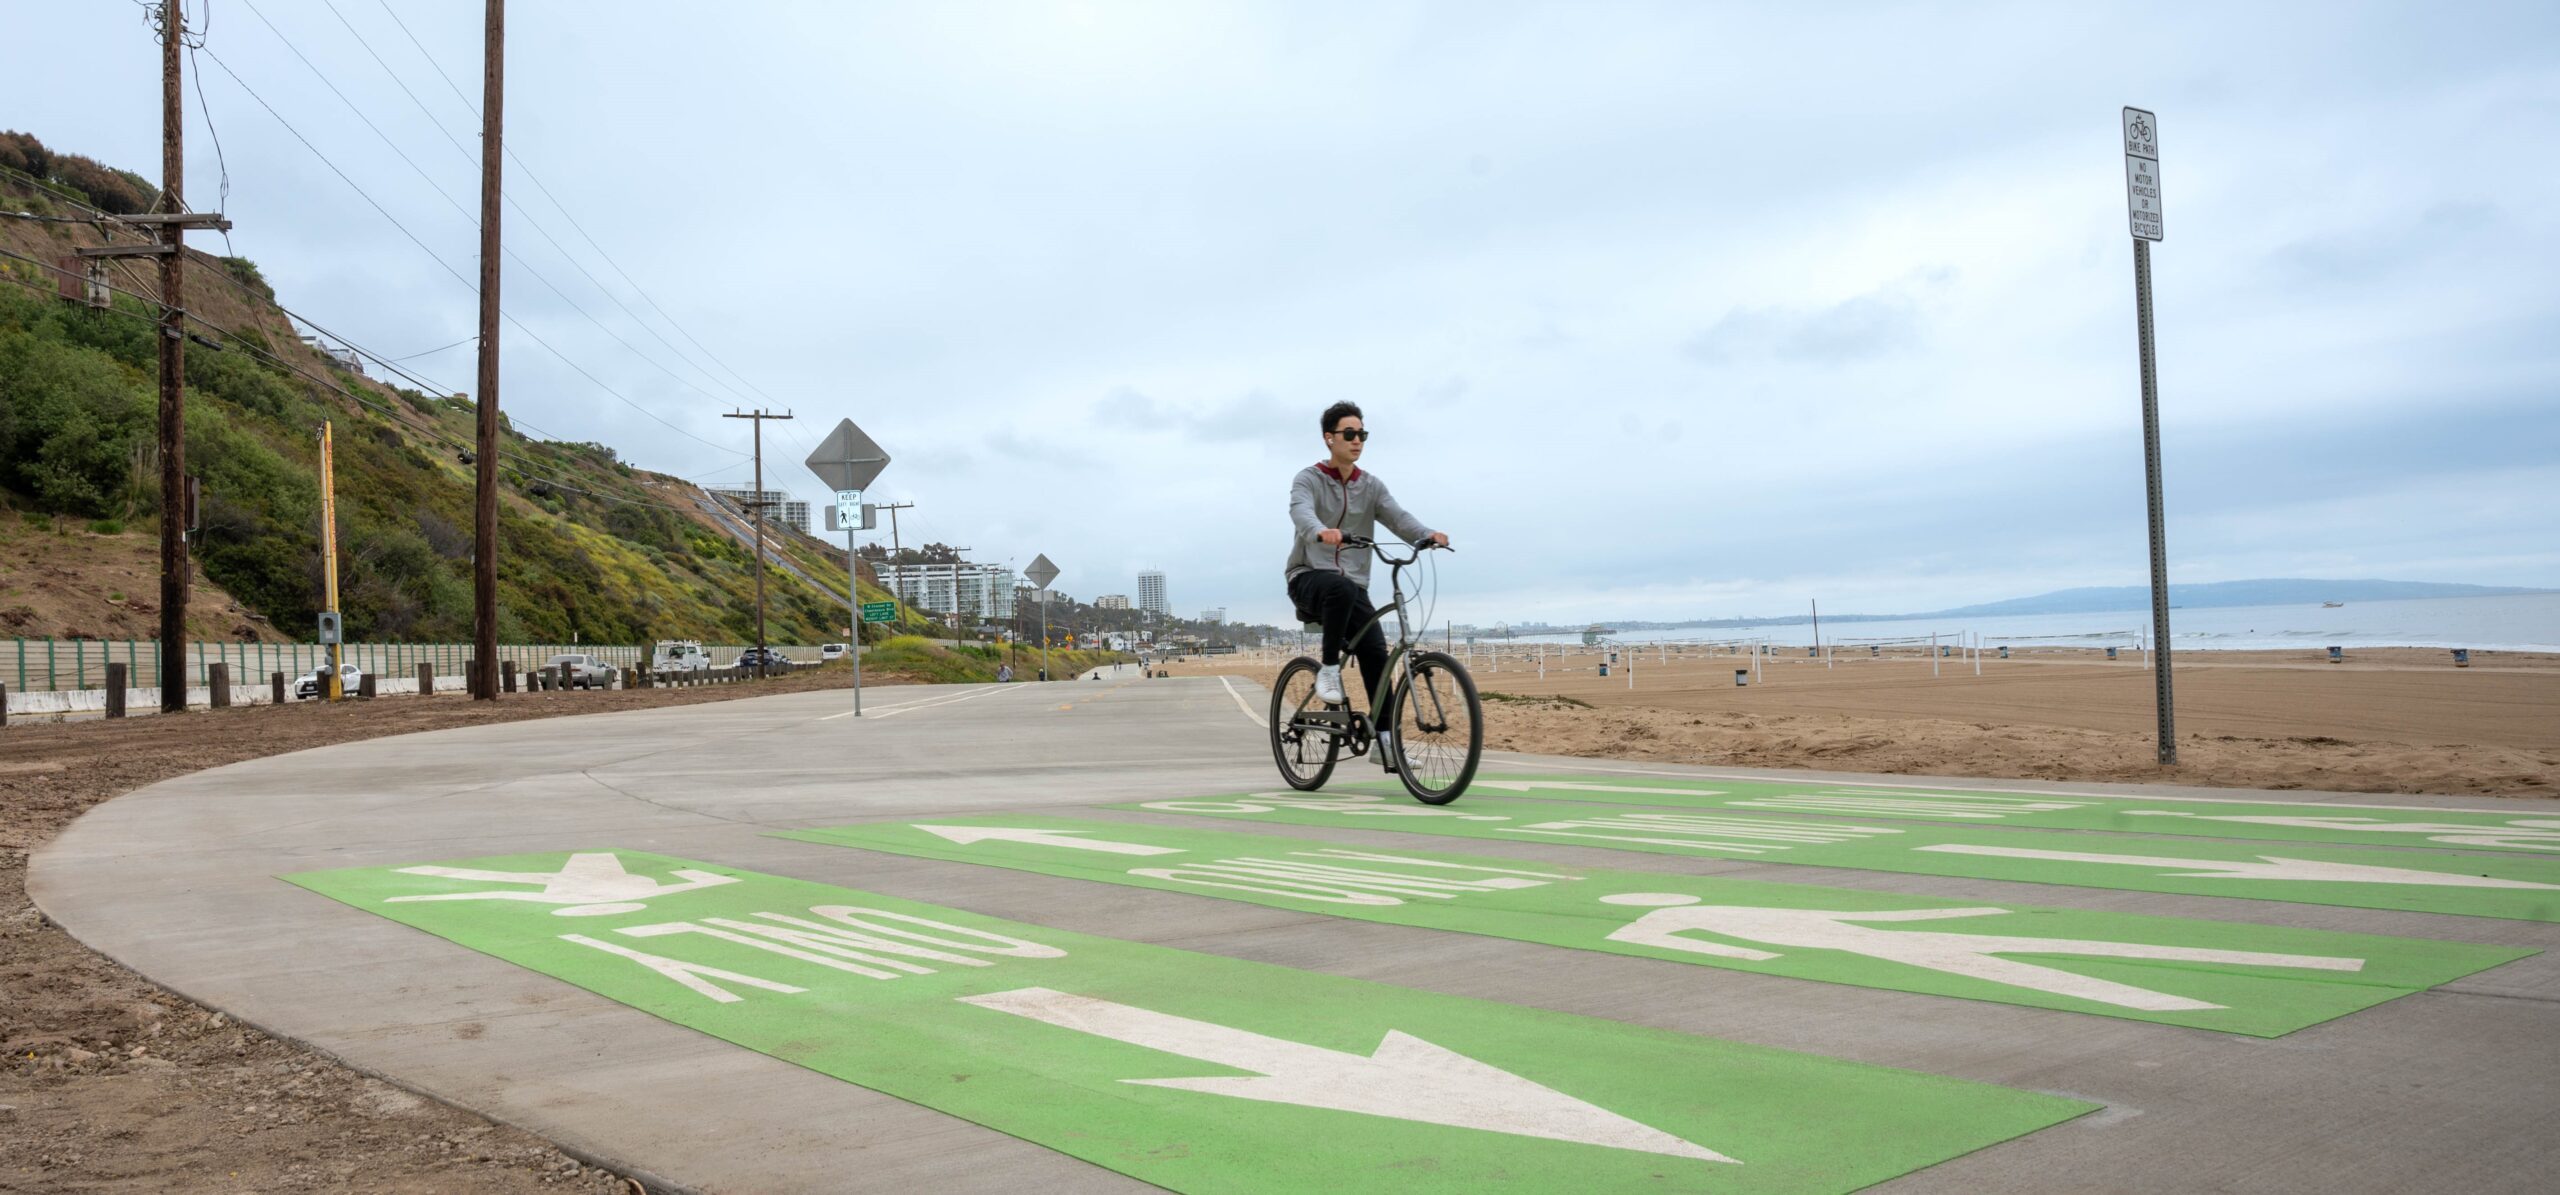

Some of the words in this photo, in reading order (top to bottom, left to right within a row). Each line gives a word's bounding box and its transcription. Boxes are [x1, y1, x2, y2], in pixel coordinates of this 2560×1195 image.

[2128, 141, 2141, 153] BIKE
[2143, 144, 2155, 155] PATH
[2139, 162, 2146, 173] NO
[2134, 173, 2152, 186] MOTOR
[2132, 185, 2157, 198] VEHICLES
[2141, 198, 2149, 209] OR
[2132, 210, 2159, 223] MOTORIZED
[2134, 222, 2159, 235] BICYCLES
[841, 493, 857, 501] KEEP
[1725, 788, 2105, 818] ONLY
[1495, 813, 1905, 854] ONLY
[1127, 848, 1588, 906] ONLY
[557, 904, 1069, 1003] ONLY
